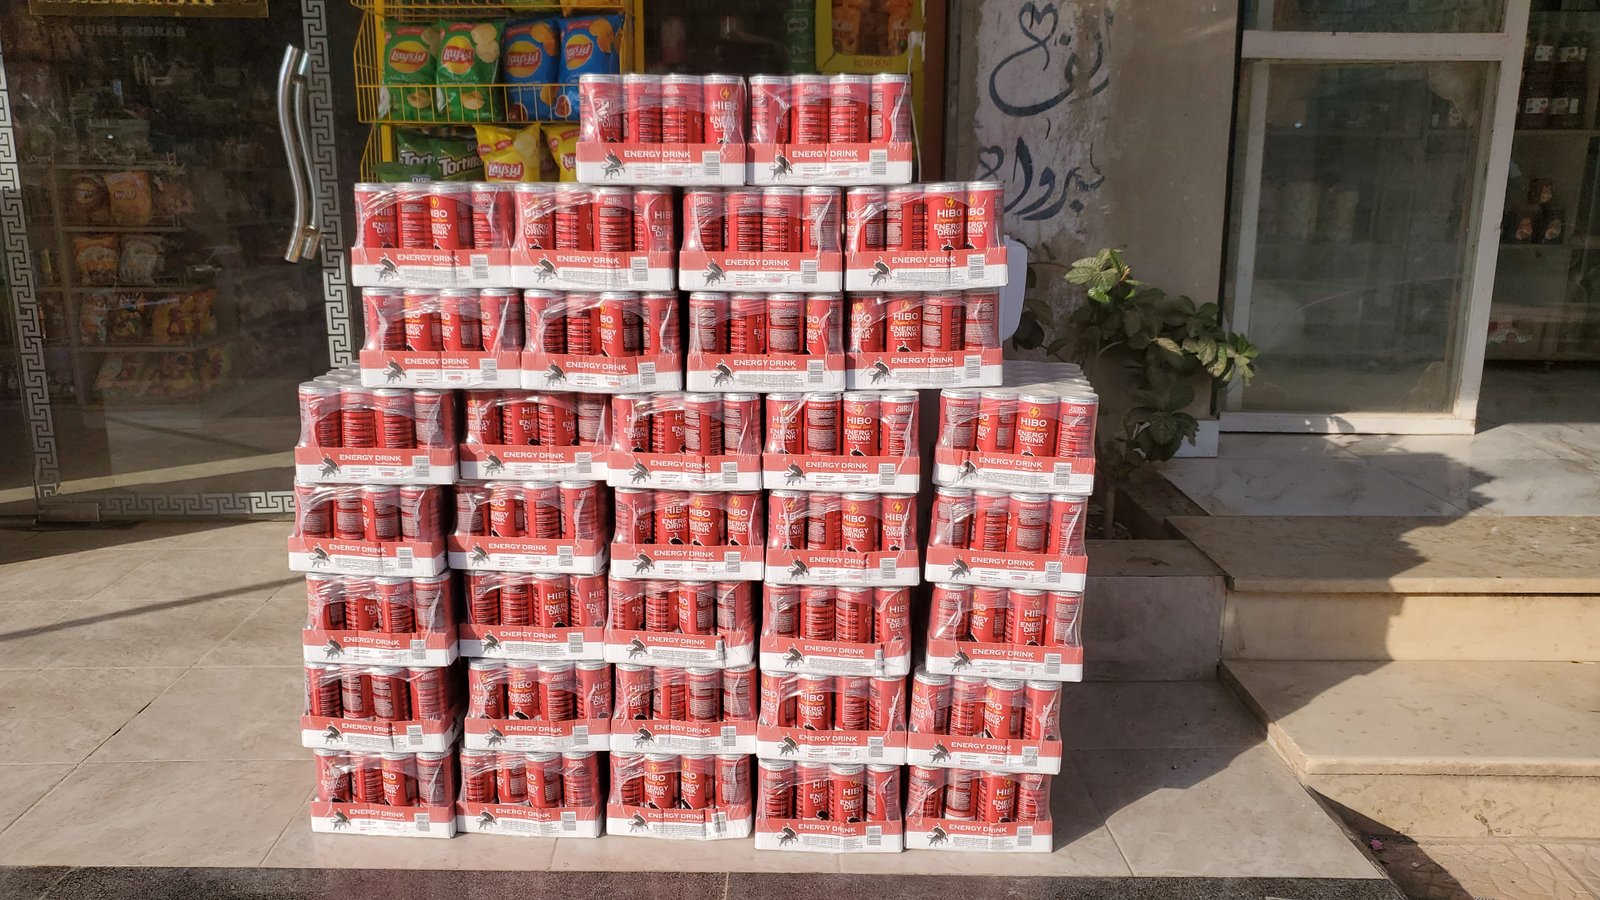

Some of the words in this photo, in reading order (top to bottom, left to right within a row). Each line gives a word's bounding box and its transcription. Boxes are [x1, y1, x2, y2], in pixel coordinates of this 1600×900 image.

[624, 151, 660, 159] ENERGY
[663, 150, 691, 159] DRINK
[792, 150, 829, 159] ENERGY
[830, 150, 858, 158] DRINK
[397, 254, 431, 262] ENERGY
[557, 255, 592, 264] ENERGY
[734, 359, 767, 367] ENERGY
[891, 356, 925, 364] ENERGY
[566, 361, 600, 369] ENERGY
[602, 363, 627, 371] DRINK
[1021, 417, 1047, 426] HIBO
[1017, 430, 1048, 438] ENERGY
[339, 454, 373, 462] ENERGY
[504, 451, 537, 459] ENERGY
[684, 461, 710, 469] DRINK
[806, 461, 839, 469] ENERGY
[979, 457, 1014, 466] ENERGY
[1016, 460, 1043, 468] DRINK
[329, 544, 362, 552] ENERGY
[363, 546, 388, 554] DRINK
[488, 543, 520, 551] ENERGY
[654, 550, 686, 558] ENERGY
[809, 556, 842, 564] ENERGY
[971, 557, 1006, 565] ENERGY
[1008, 559, 1034, 567] DRINK
[500, 631, 532, 639] ENERGY
[343, 636, 374, 644] ENERGY
[647, 636, 678, 644] ENERGY
[804, 645, 836, 654] ENERGY
[839, 647, 864, 655] DRINK
[972, 648, 1006, 657] ENERGY
[1007, 650, 1034, 658] DRINK
[800, 693, 824, 701] HIBO
[342, 723, 372, 731] ENERGY
[373, 724, 396, 732] DRINK
[505, 725, 536, 733] ENERGY
[654, 724, 684, 732] ENERGY
[951, 742, 985, 750] ENERGY
[381, 810, 405, 818] DRINK
[496, 808, 526, 816] ENERGY
[648, 812, 678, 820] ENERGY
[798, 824, 830, 832] ENERGY
